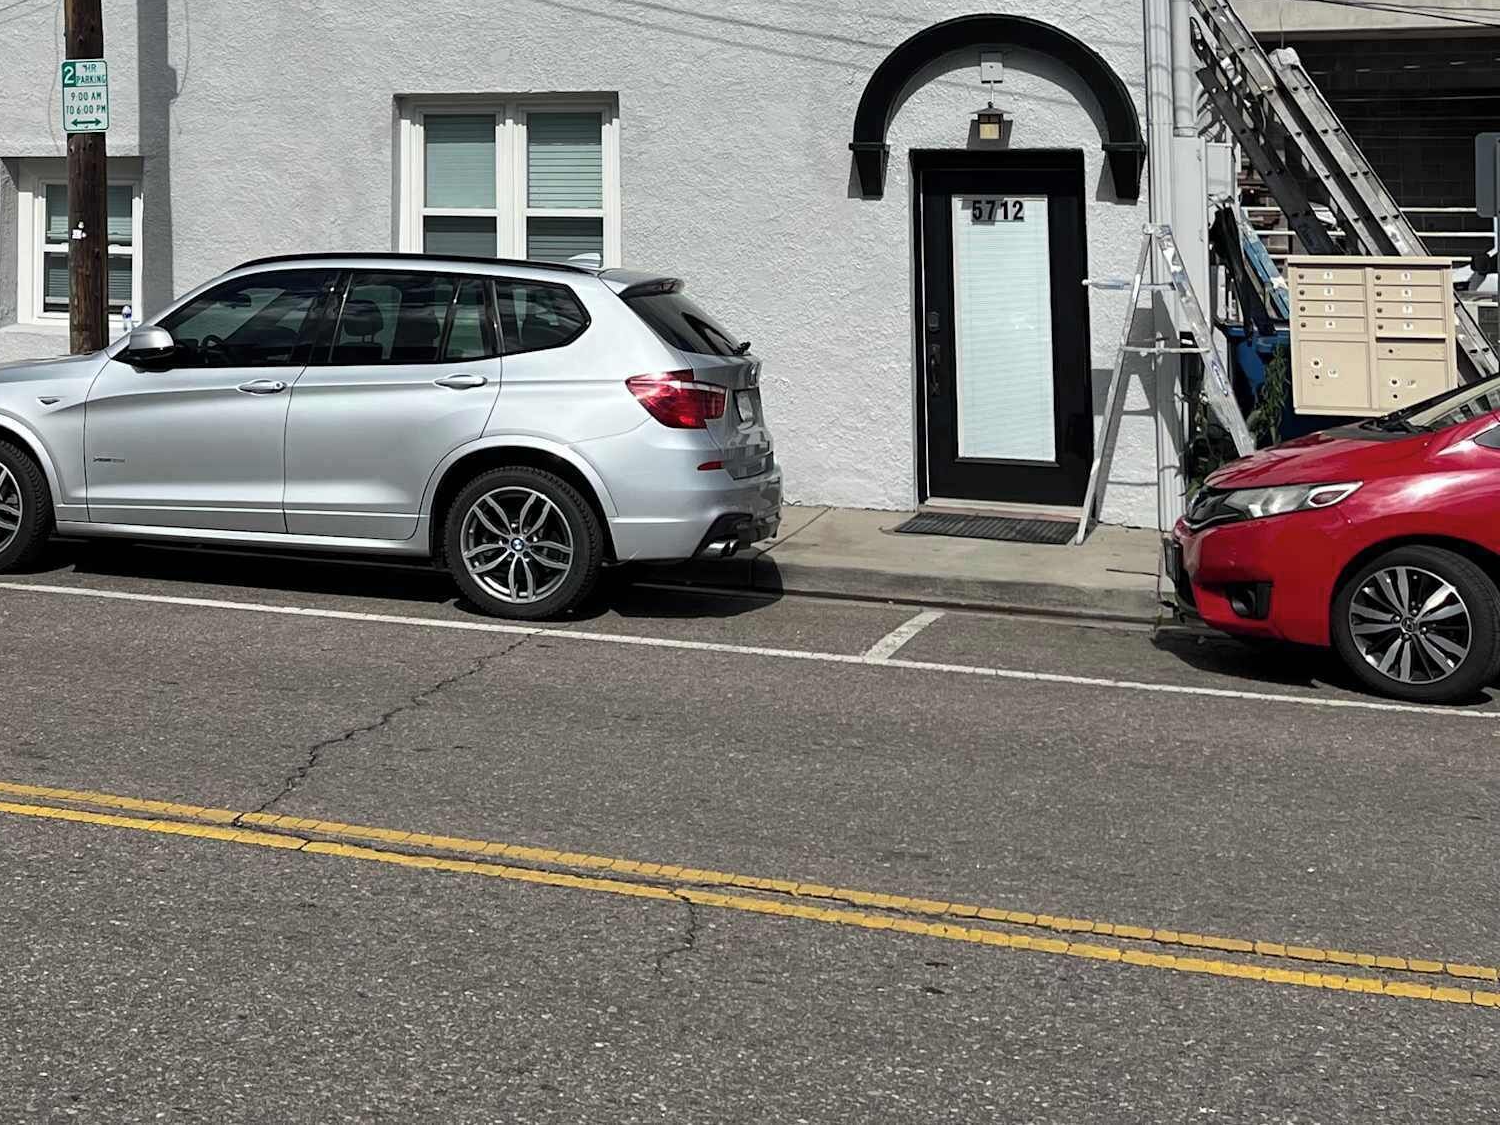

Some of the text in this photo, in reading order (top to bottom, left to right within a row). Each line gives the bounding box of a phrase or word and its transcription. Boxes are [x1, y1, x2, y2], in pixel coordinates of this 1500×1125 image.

[64, 66, 74, 84] 2
[75, 75, 106, 84] PARKING
[91, 91, 102, 101] AM
[66, 105, 75, 115] TO
[96, 105, 106, 114] PM
[972, 199, 1025, 221] 5712
